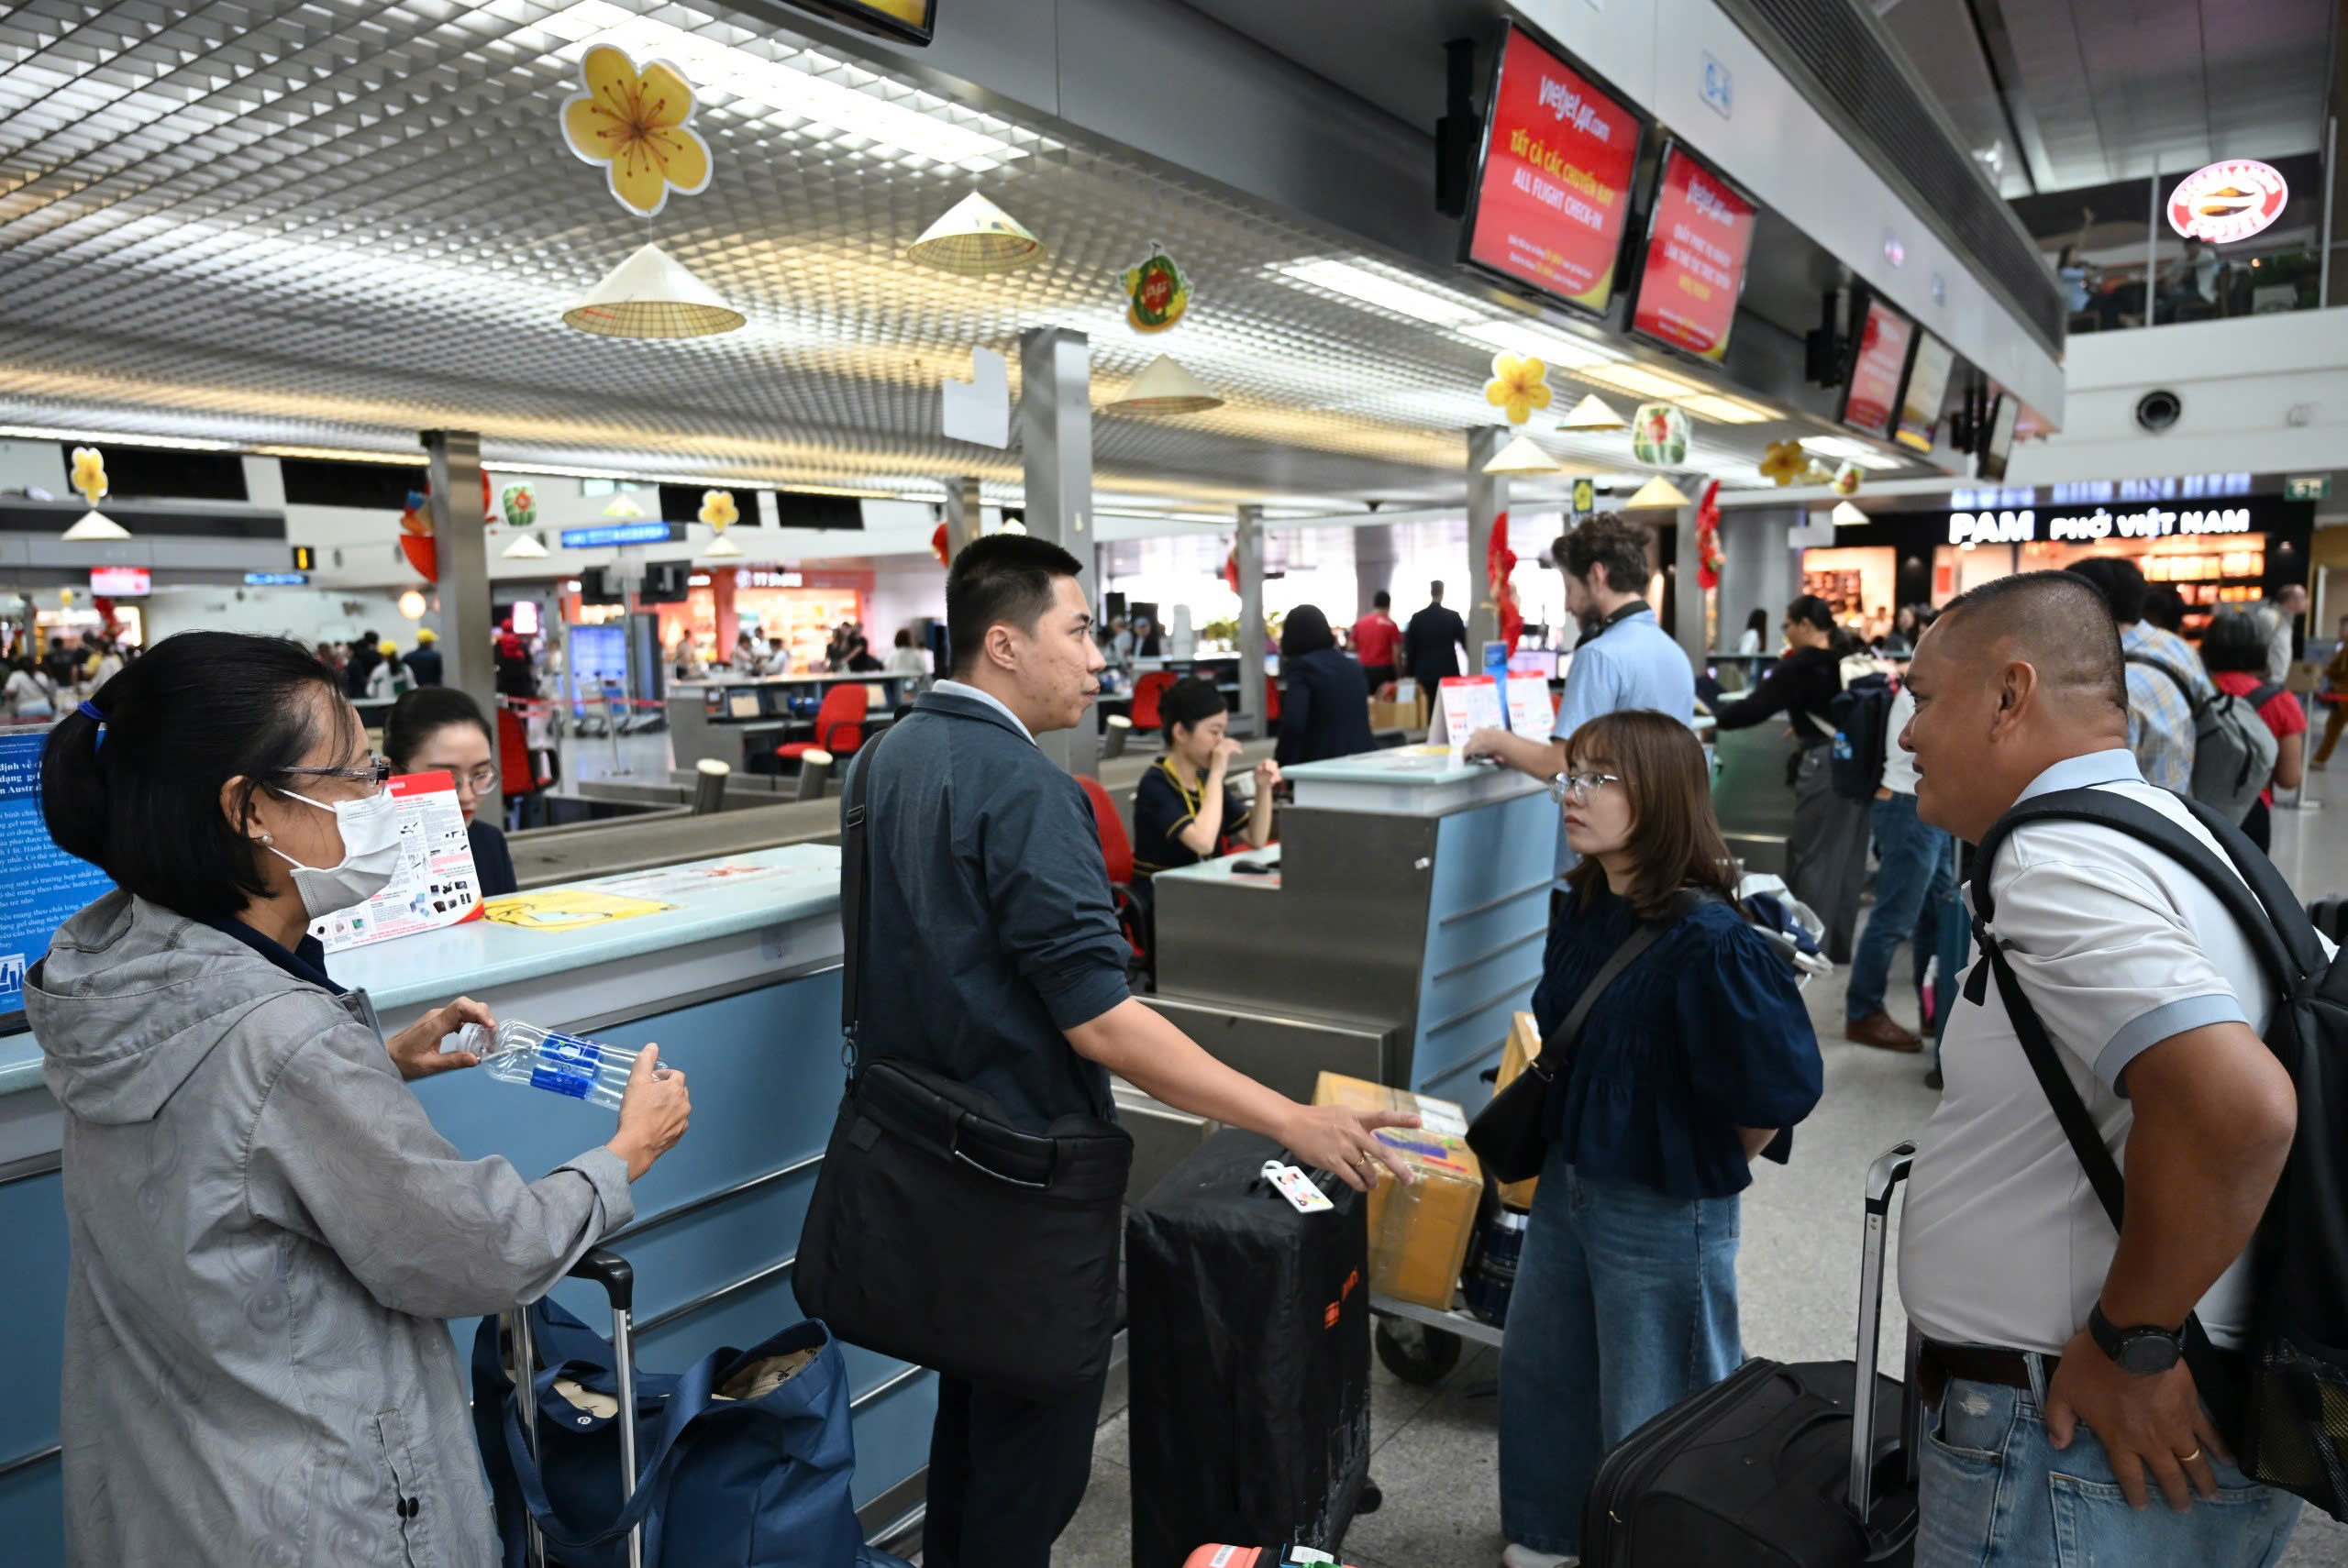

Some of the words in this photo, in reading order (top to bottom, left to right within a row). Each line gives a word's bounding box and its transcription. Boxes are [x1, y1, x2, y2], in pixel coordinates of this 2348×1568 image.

[1512, 168, 1532, 193] ALL
[1531, 177, 1566, 210] FLIGHT
[1564, 195, 1603, 230] CHECK-IN
[2179, 508, 2251, 535] NAM
